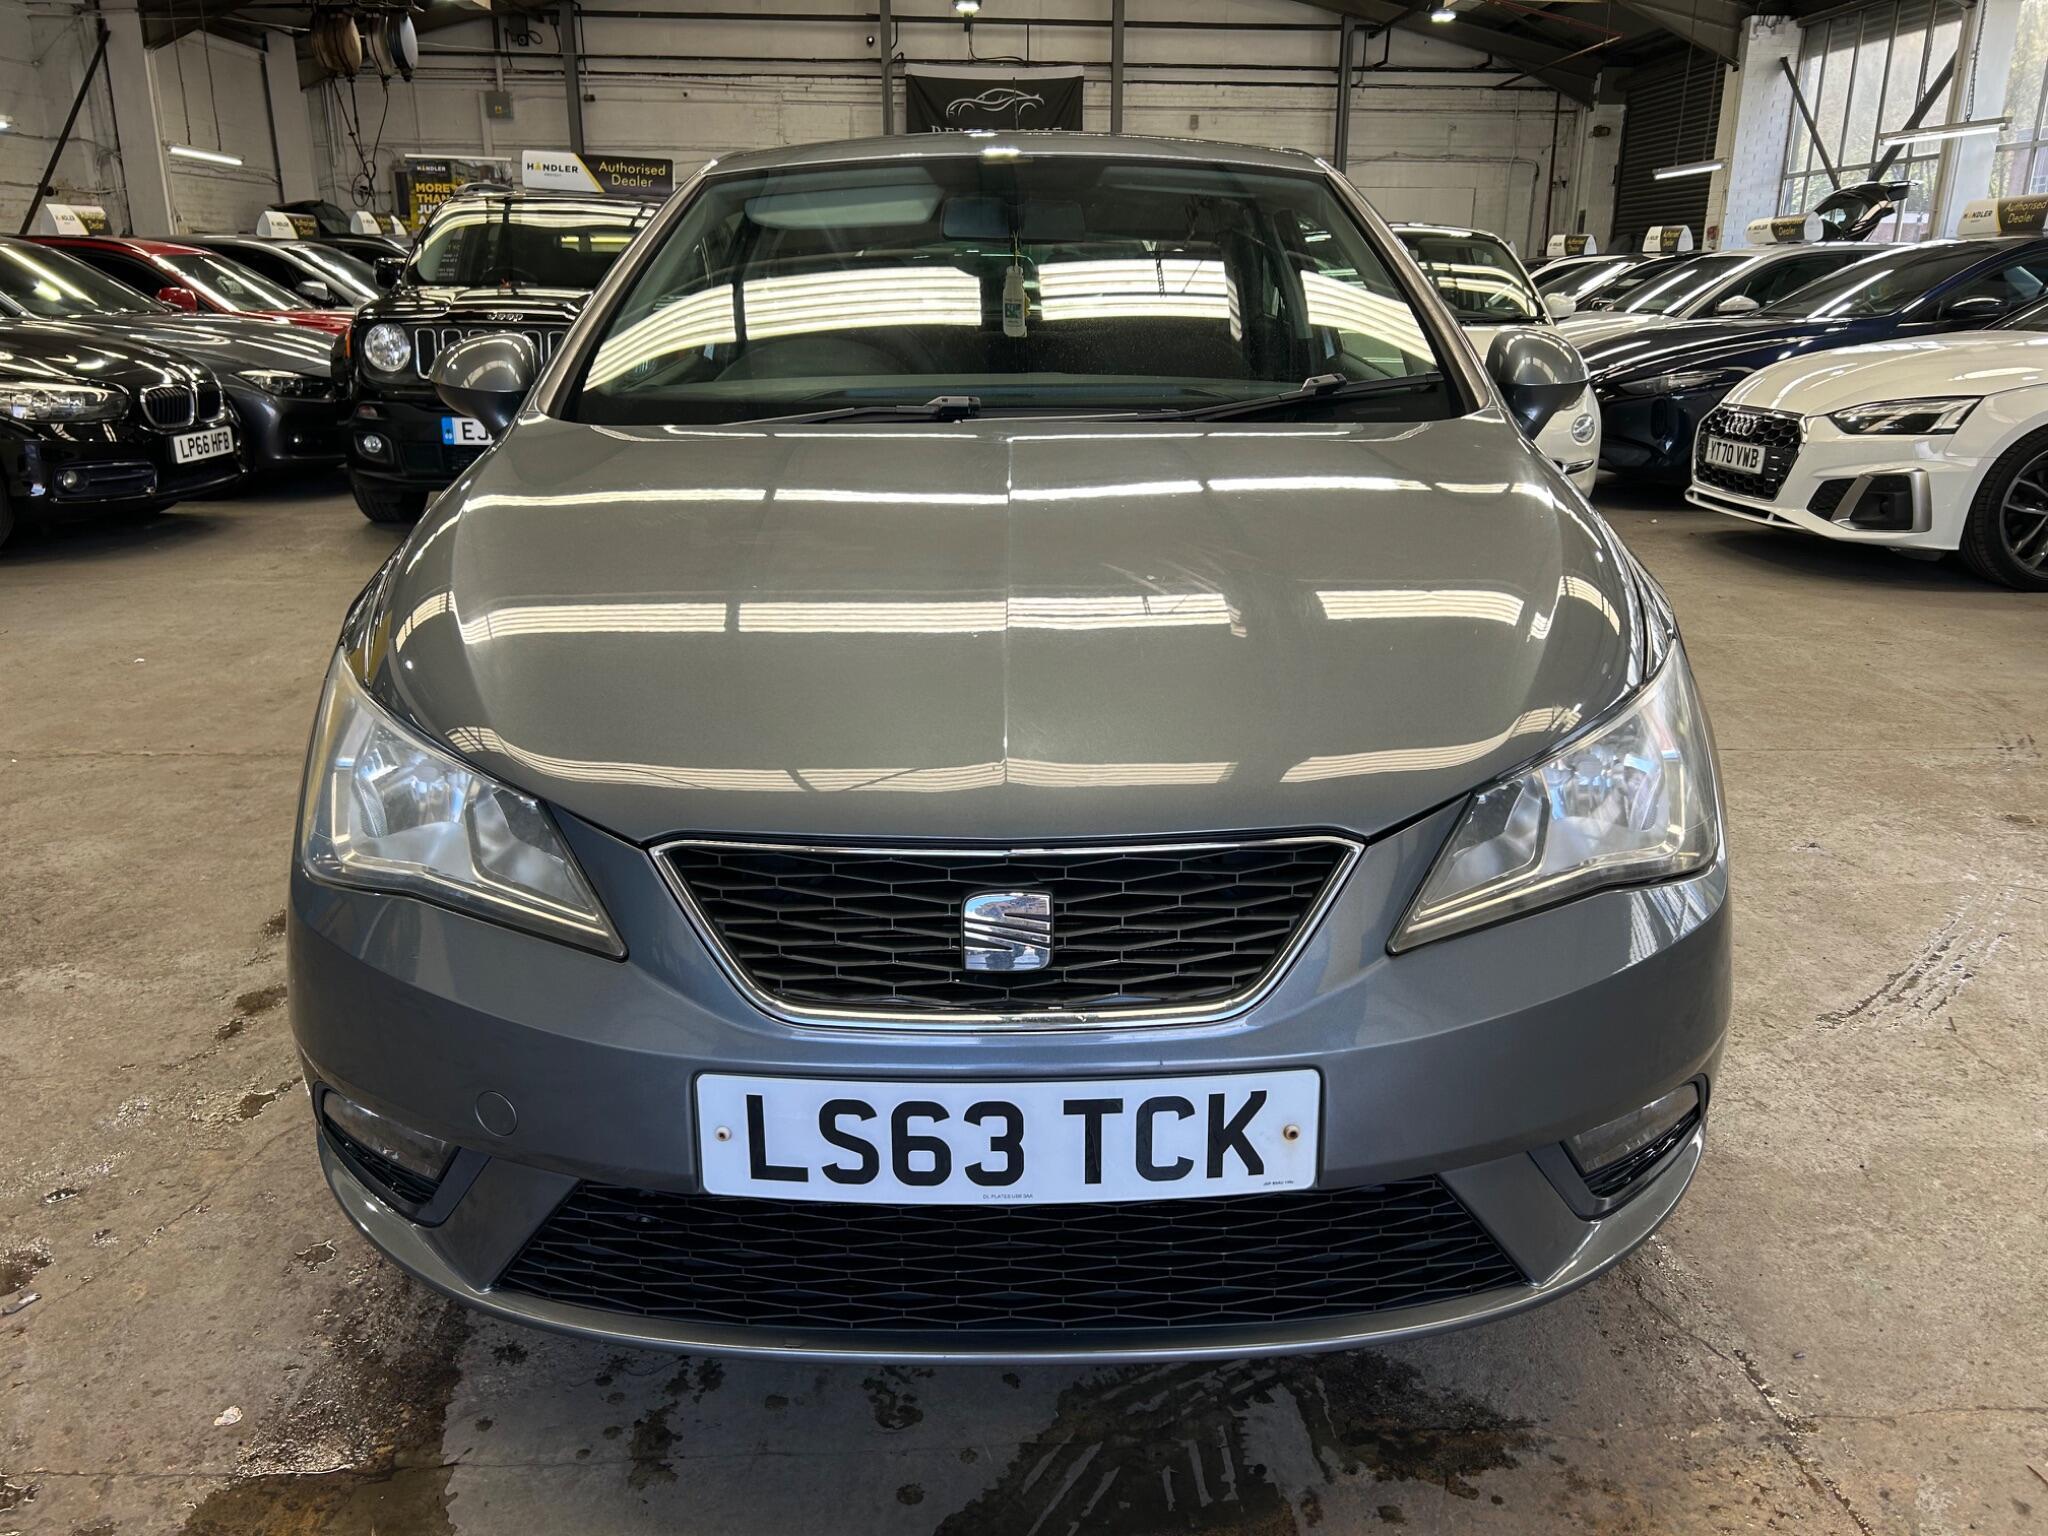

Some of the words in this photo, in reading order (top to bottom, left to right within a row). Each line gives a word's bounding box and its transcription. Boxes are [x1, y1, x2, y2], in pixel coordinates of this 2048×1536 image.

[526, 162, 579, 174] HANDLER
[598, 161, 666, 176] Authorised
[415, 182, 450, 193] MORE
[611, 174, 653, 188] Dealer
[2007, 211, 2035, 224] Dealer
[180, 434, 210, 459] LP66
[210, 431, 230, 453] HFB
[1710, 440, 1734, 464] YT70
[746, 1094, 1025, 1187] LS63
[1063, 1090, 1268, 1185] TCK
